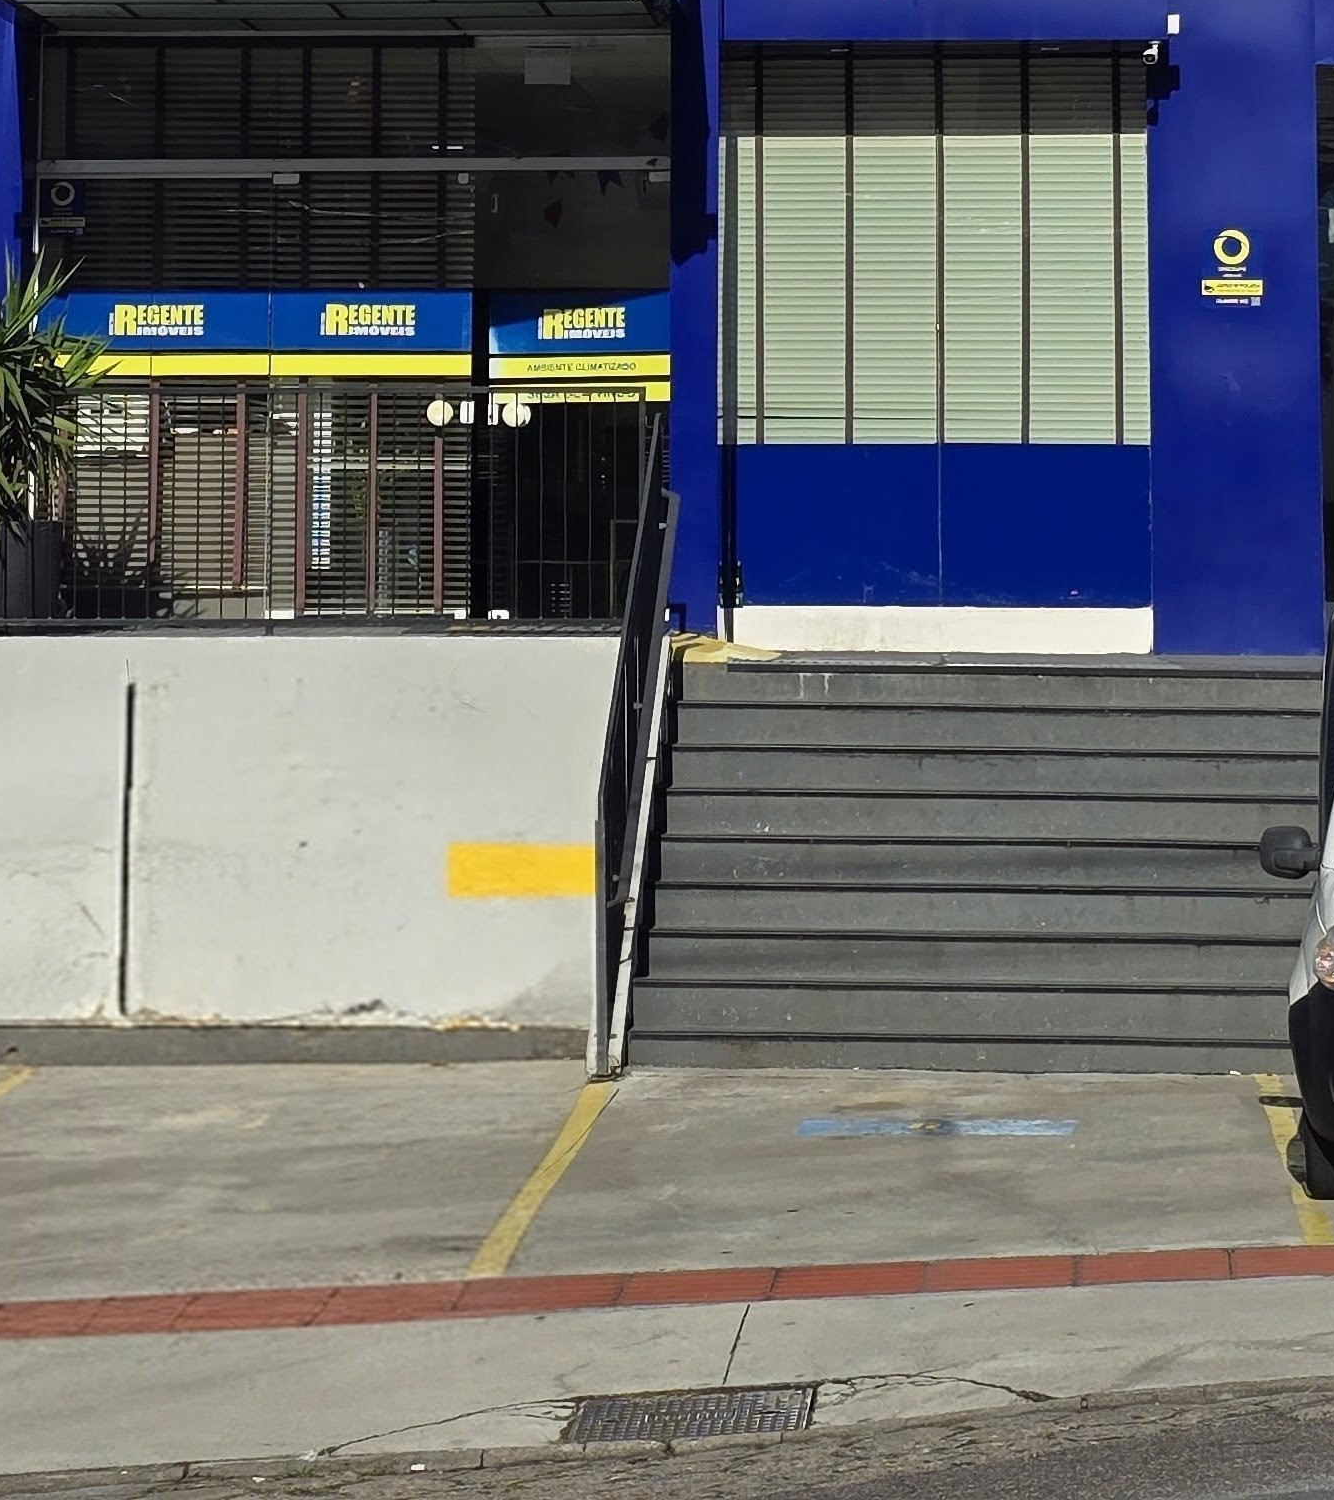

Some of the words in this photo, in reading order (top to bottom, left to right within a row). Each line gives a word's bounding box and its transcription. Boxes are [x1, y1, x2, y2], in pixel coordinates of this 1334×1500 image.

[114, 304, 205, 336] REGENTE
[325, 303, 416, 336] REGENTE
[542, 307, 626, 339] REGENTE
